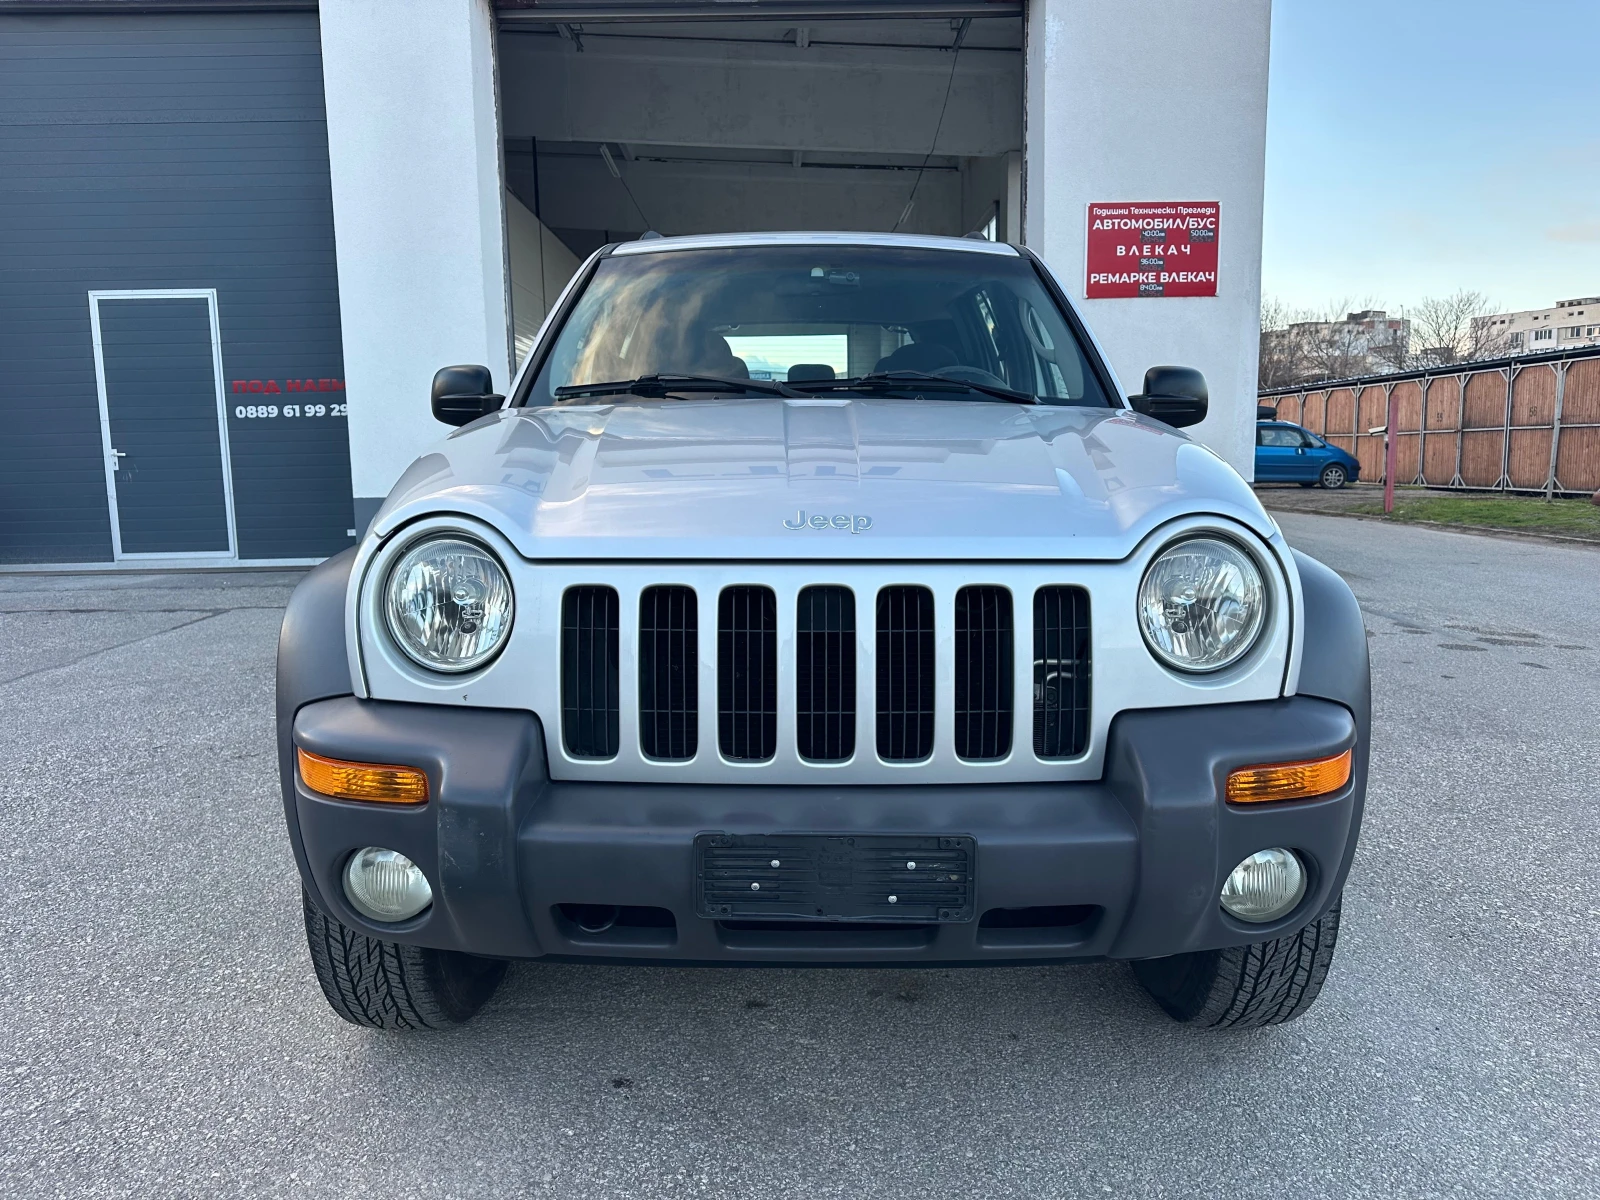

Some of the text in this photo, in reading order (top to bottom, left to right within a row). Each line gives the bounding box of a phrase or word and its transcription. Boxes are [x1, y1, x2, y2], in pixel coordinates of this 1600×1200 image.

[1093, 206, 1216, 216] Годишни Технически Прегледи
[1093, 217, 1216, 230] АВТОМОБИЛ/БУС
[1090, 271, 1215, 284] РЕМАРКЕ ВЛЕКАЧ
[232, 380, 281, 395] ПОД
[235, 404, 348, 418] 0889 61 99 29
[782, 510, 874, 535] Jeep
